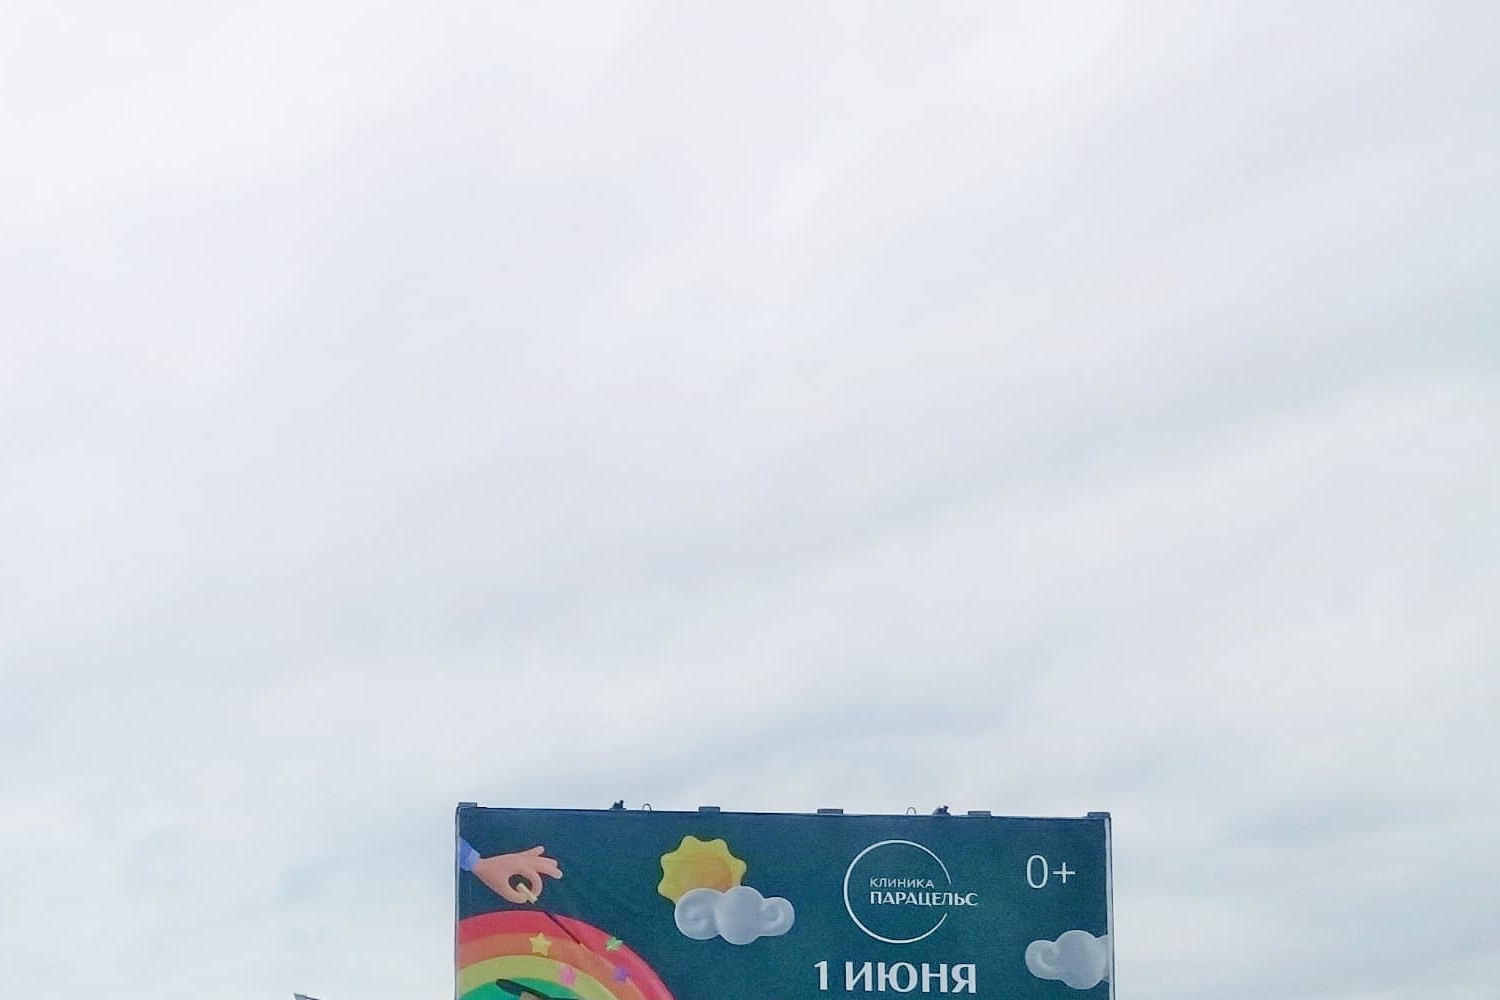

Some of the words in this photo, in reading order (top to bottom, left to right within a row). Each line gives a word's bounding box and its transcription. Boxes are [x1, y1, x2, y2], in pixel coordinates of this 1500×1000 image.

[869, 877, 935, 889] КЛИНИКА
[1025, 854, 1076, 889] 0+
[869, 891, 980, 907] ПАРАЦЕЛЬС
[813, 960, 829, 991] 1
[844, 961, 977, 993] ИЮНЯ
